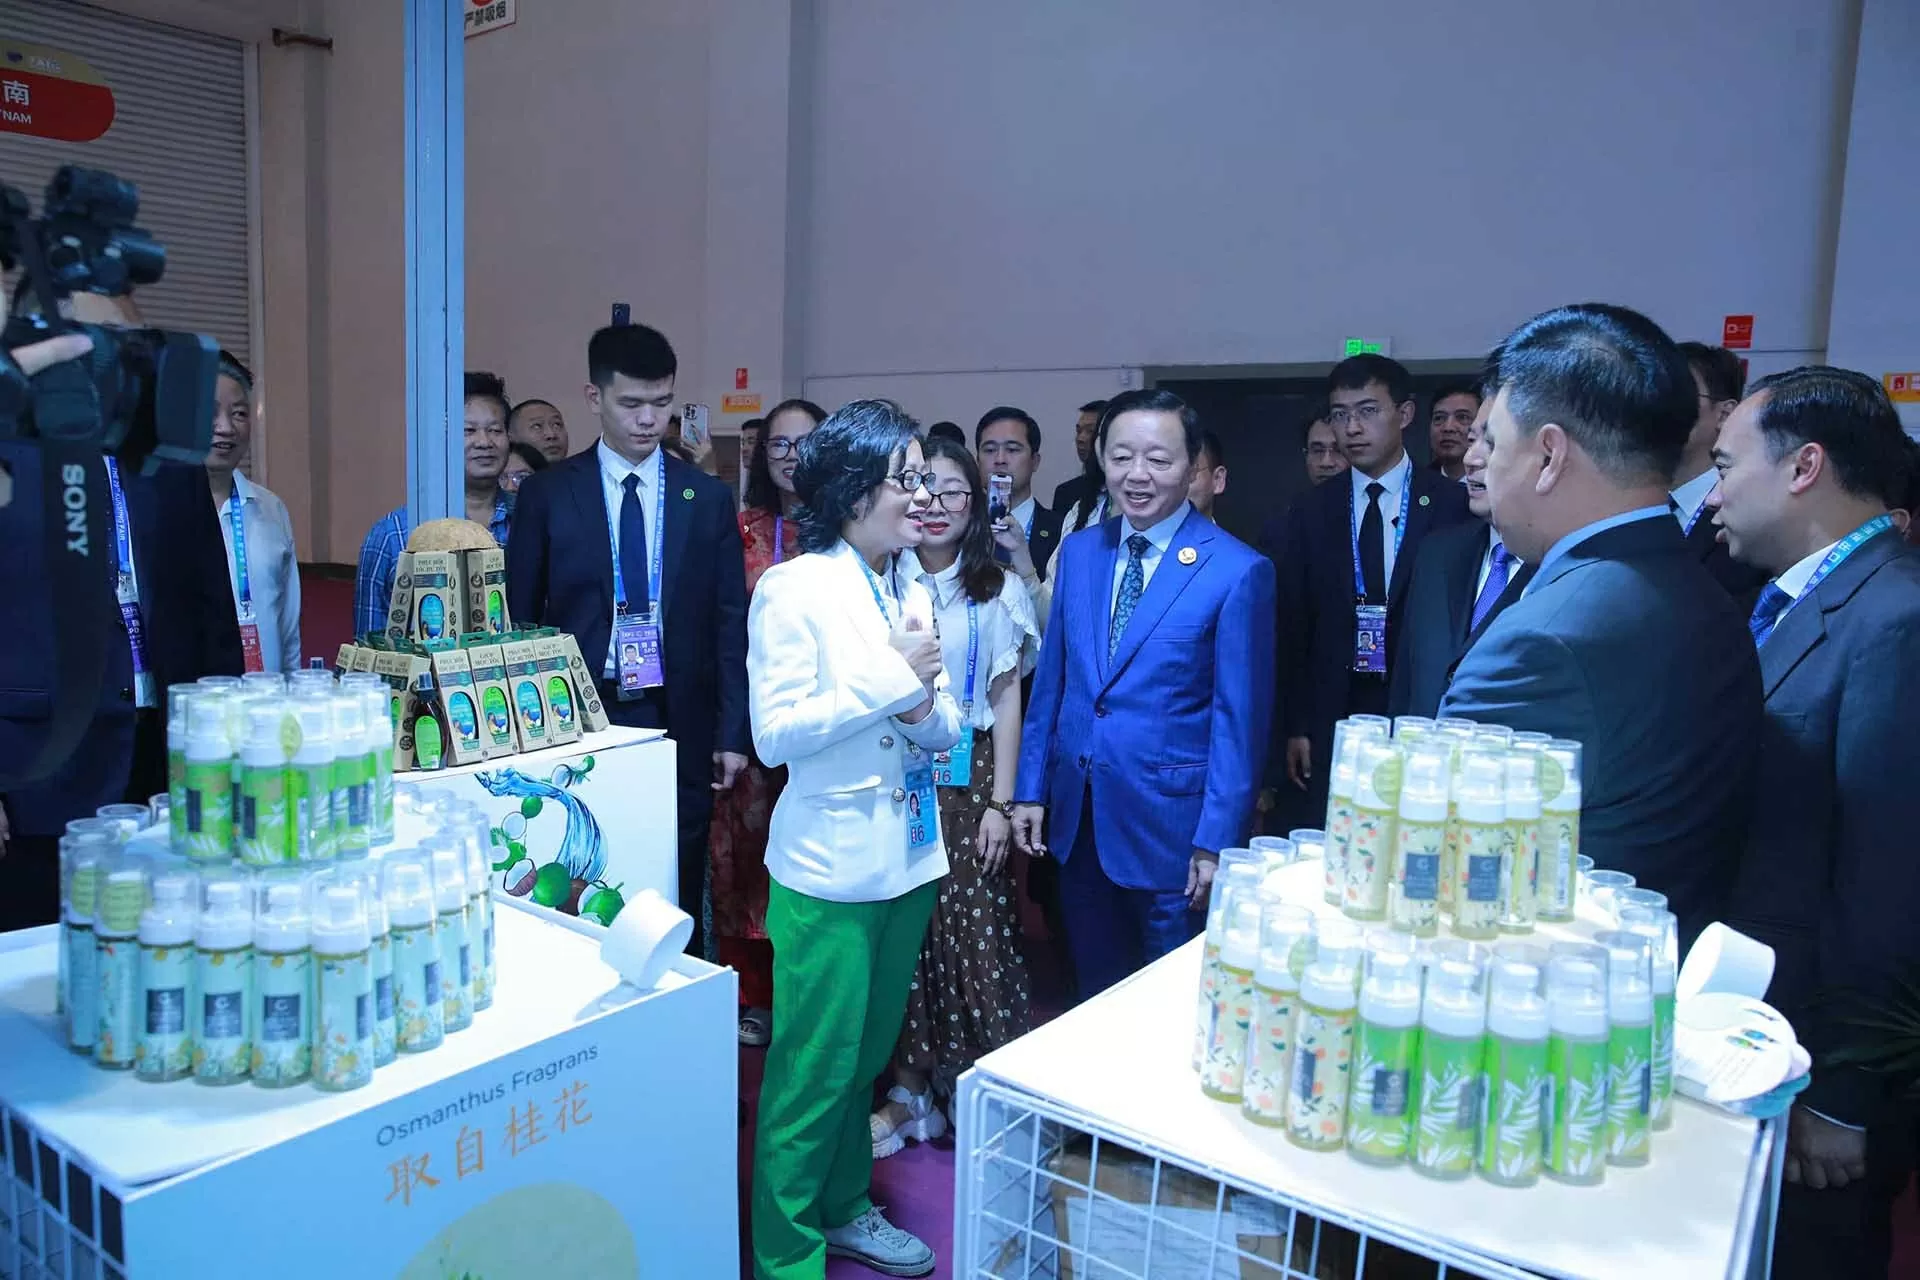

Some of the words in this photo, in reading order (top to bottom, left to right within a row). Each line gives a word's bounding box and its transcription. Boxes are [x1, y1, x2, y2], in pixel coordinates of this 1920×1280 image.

[2, 80, 30, 107] 南
[62, 464, 89, 557] SONY
[376, 1082, 505, 1147] Osmanthus
[512, 1044, 599, 1092] Fragrans
[384, 1079, 593, 1207] 取自桂花
